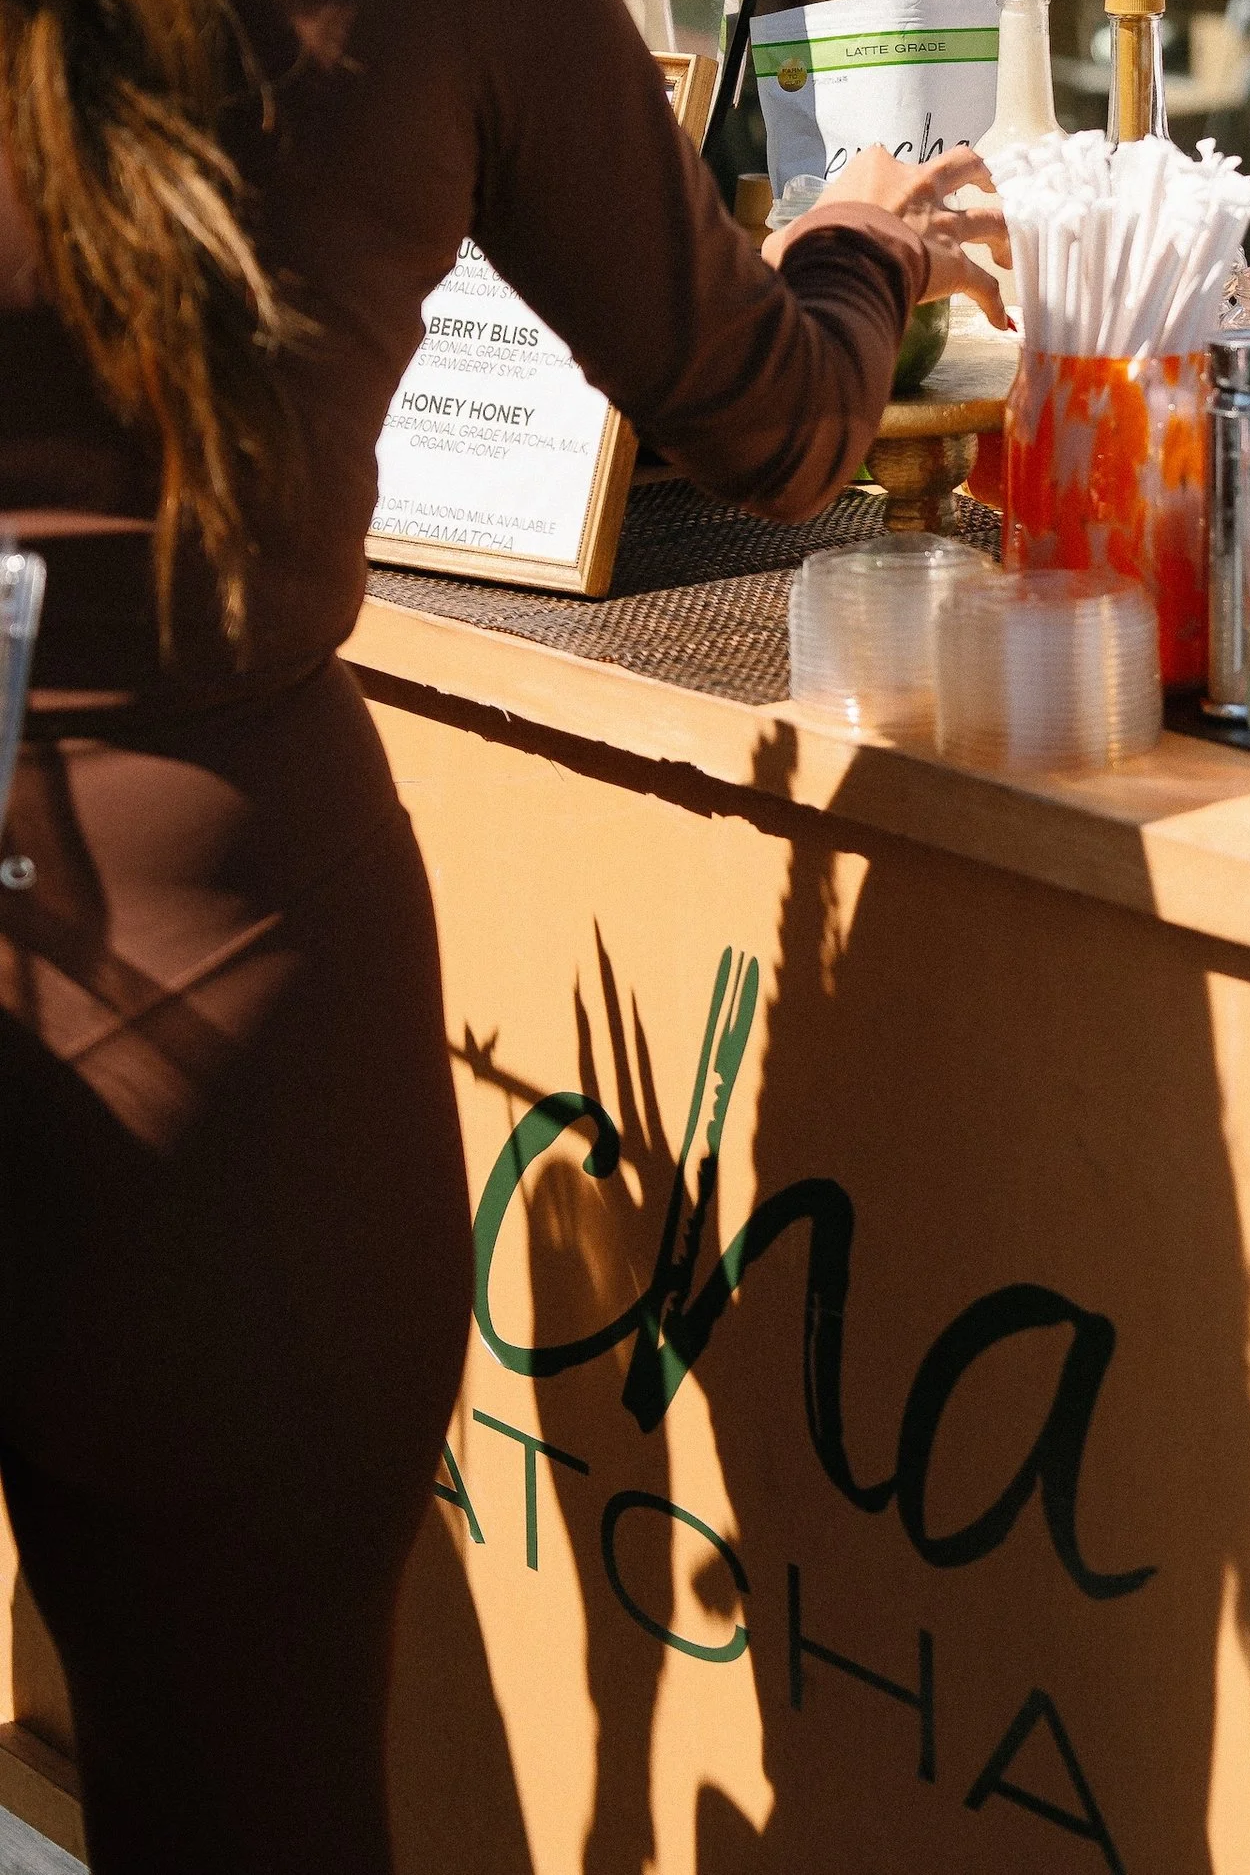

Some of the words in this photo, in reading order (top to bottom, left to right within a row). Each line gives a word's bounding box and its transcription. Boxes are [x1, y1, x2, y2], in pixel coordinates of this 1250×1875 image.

[845, 44, 889, 57] LATTE
[894, 42, 947, 54] GRADE
[451, 264, 488, 281] ONIAL
[437, 278, 500, 297] HMALLOW
[429, 316, 488, 340] BERRY
[490, 323, 539, 347] BLISS
[418, 337, 473, 356] EMONIAL
[476, 344, 518, 362] GRADE
[418, 354, 496, 376] STRAWBERRY
[498, 364, 538, 381] SYRUP
[401, 392, 467, 417] HONEY
[469, 400, 536, 426] HONEY
[383, 413, 456, 436] CEREMONIAL
[458, 424, 501, 443] GRADE
[503, 430, 556, 451] MATCHA,
[410, 434, 466, 454] ORGANIC
[467, 442, 511, 460] HONEY
[387, 497, 410, 511] OAT
[416, 502, 465, 521] ALMOND
[466, 509, 495, 526] MILK
[496, 514, 557, 535] AVAILABLE
[434, 1408, 1124, 1875] ATCHA
